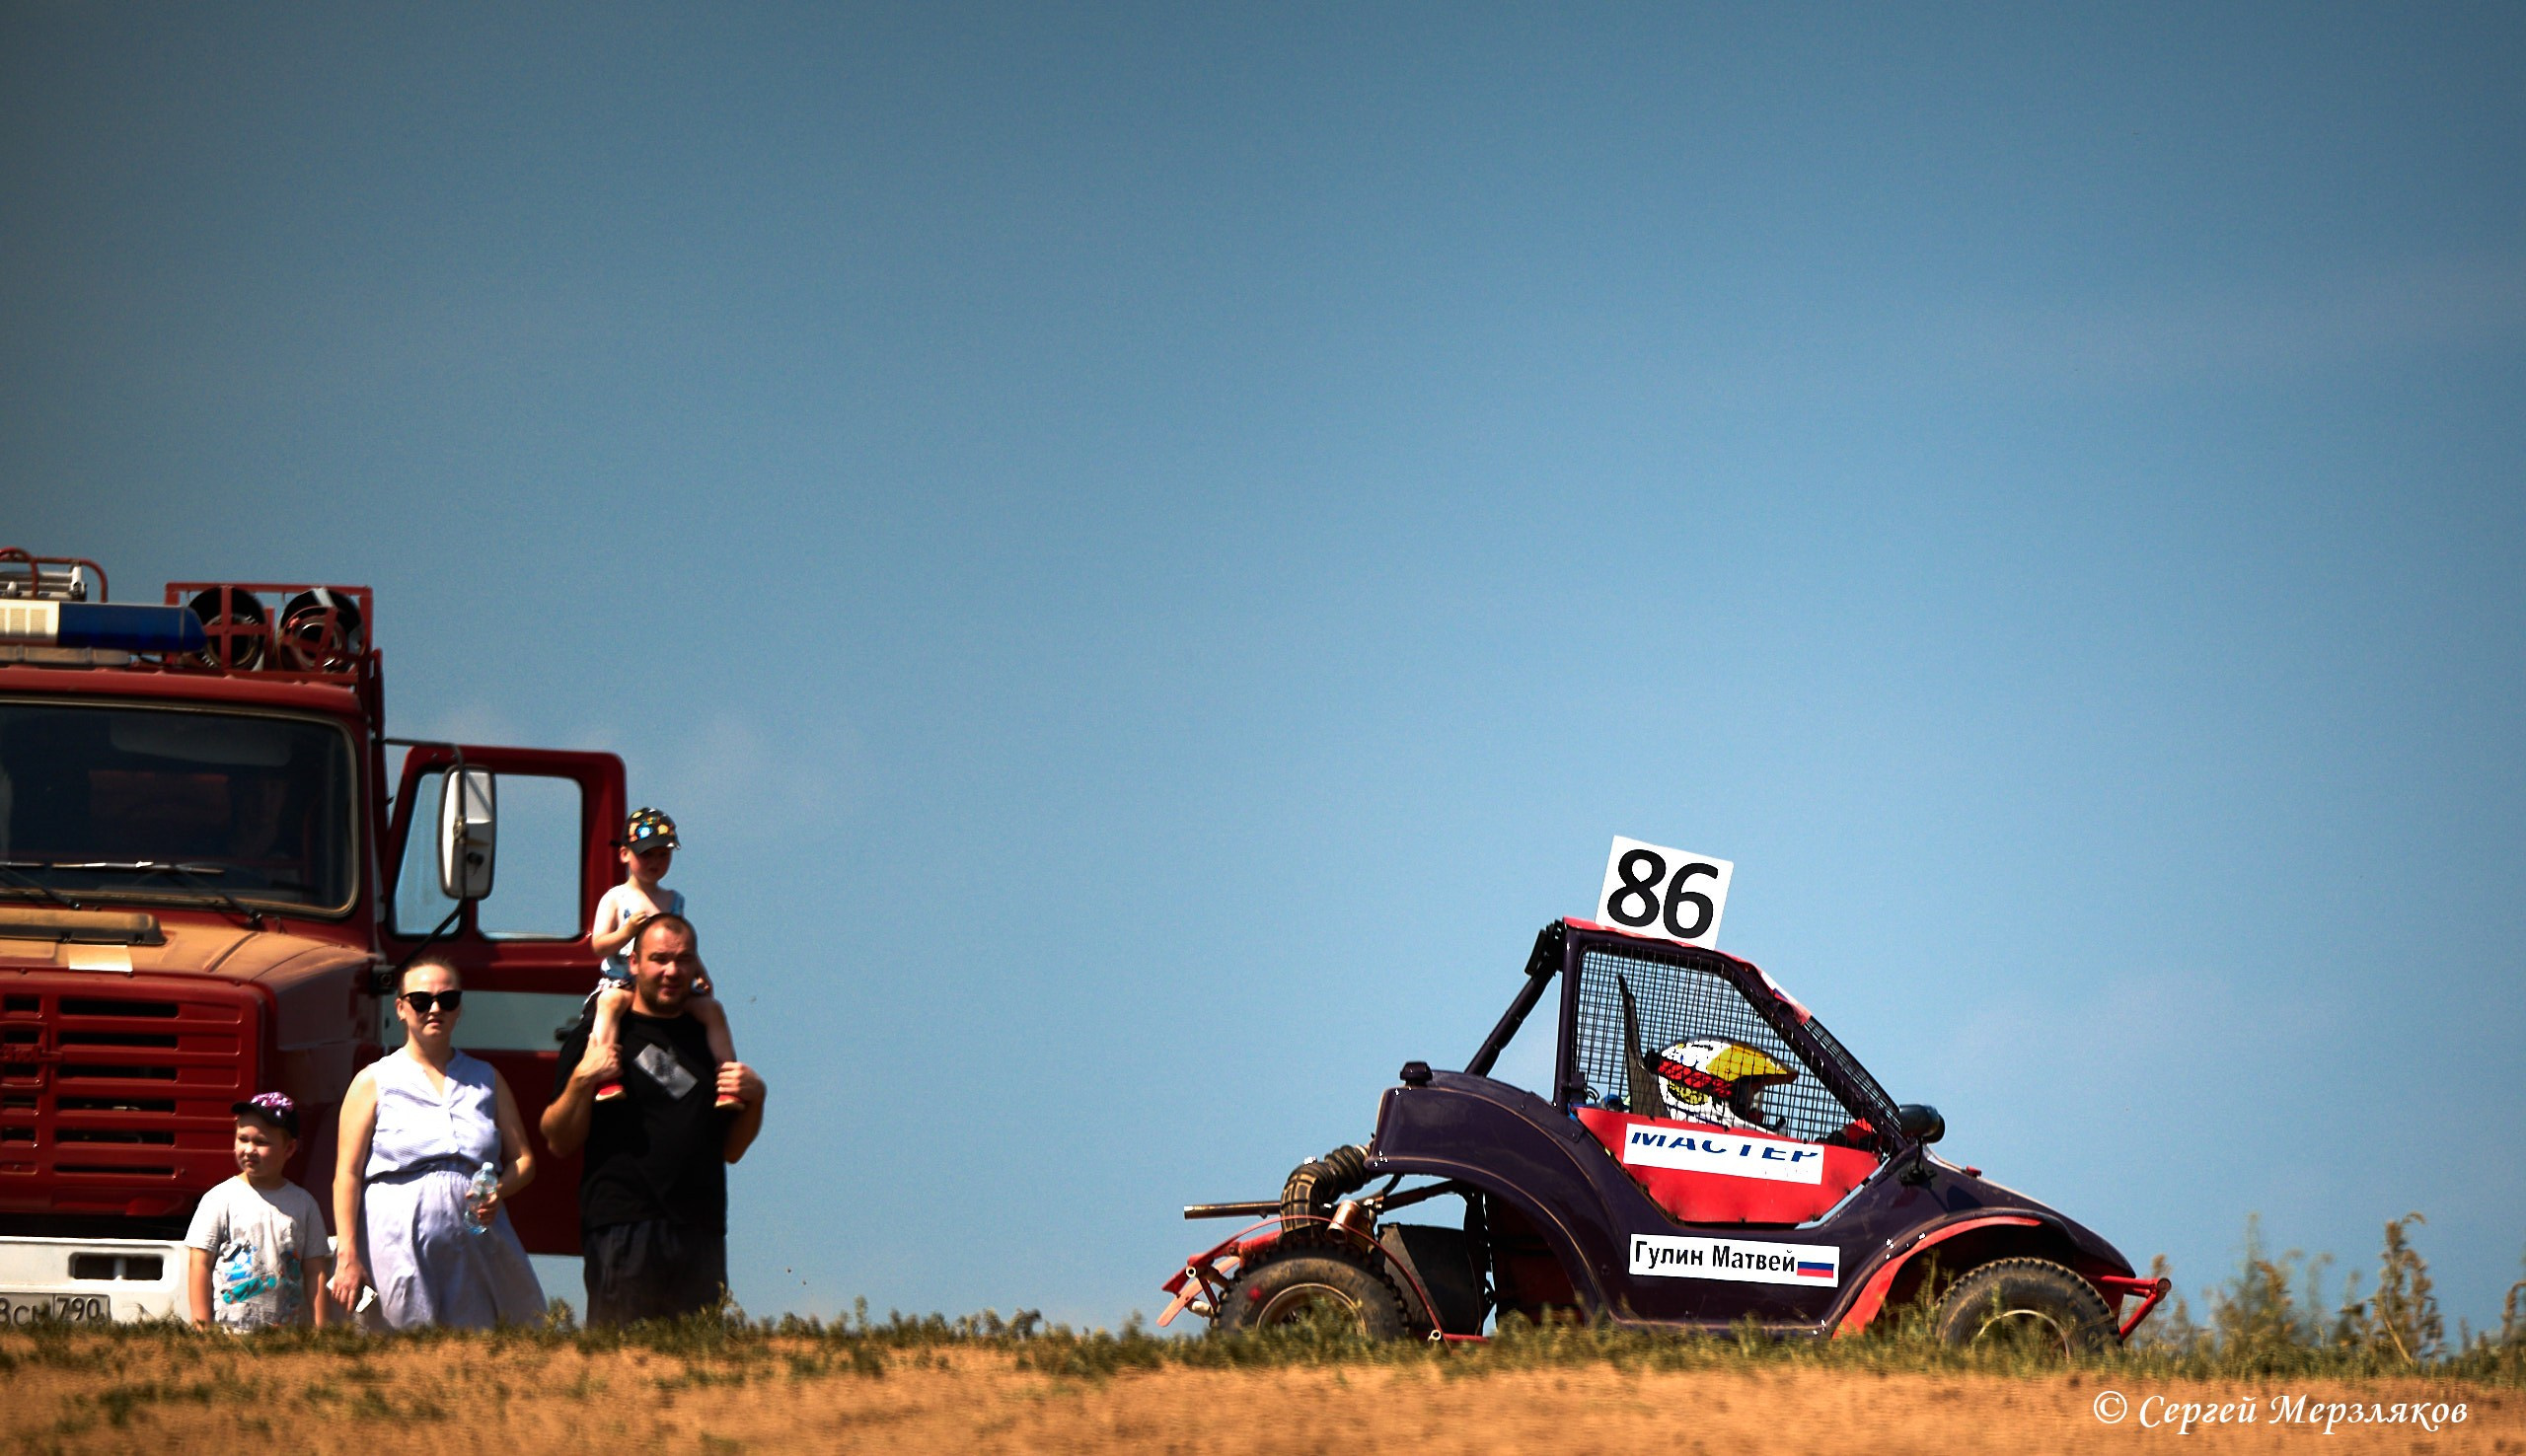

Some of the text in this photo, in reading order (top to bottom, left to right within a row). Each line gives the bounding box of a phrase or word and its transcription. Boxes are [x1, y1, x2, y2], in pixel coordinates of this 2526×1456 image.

[1606, 848, 1719, 939] 86
[1634, 1240, 1796, 1273] Гулин Матвей
[56, 1297, 101, 1321] 790
